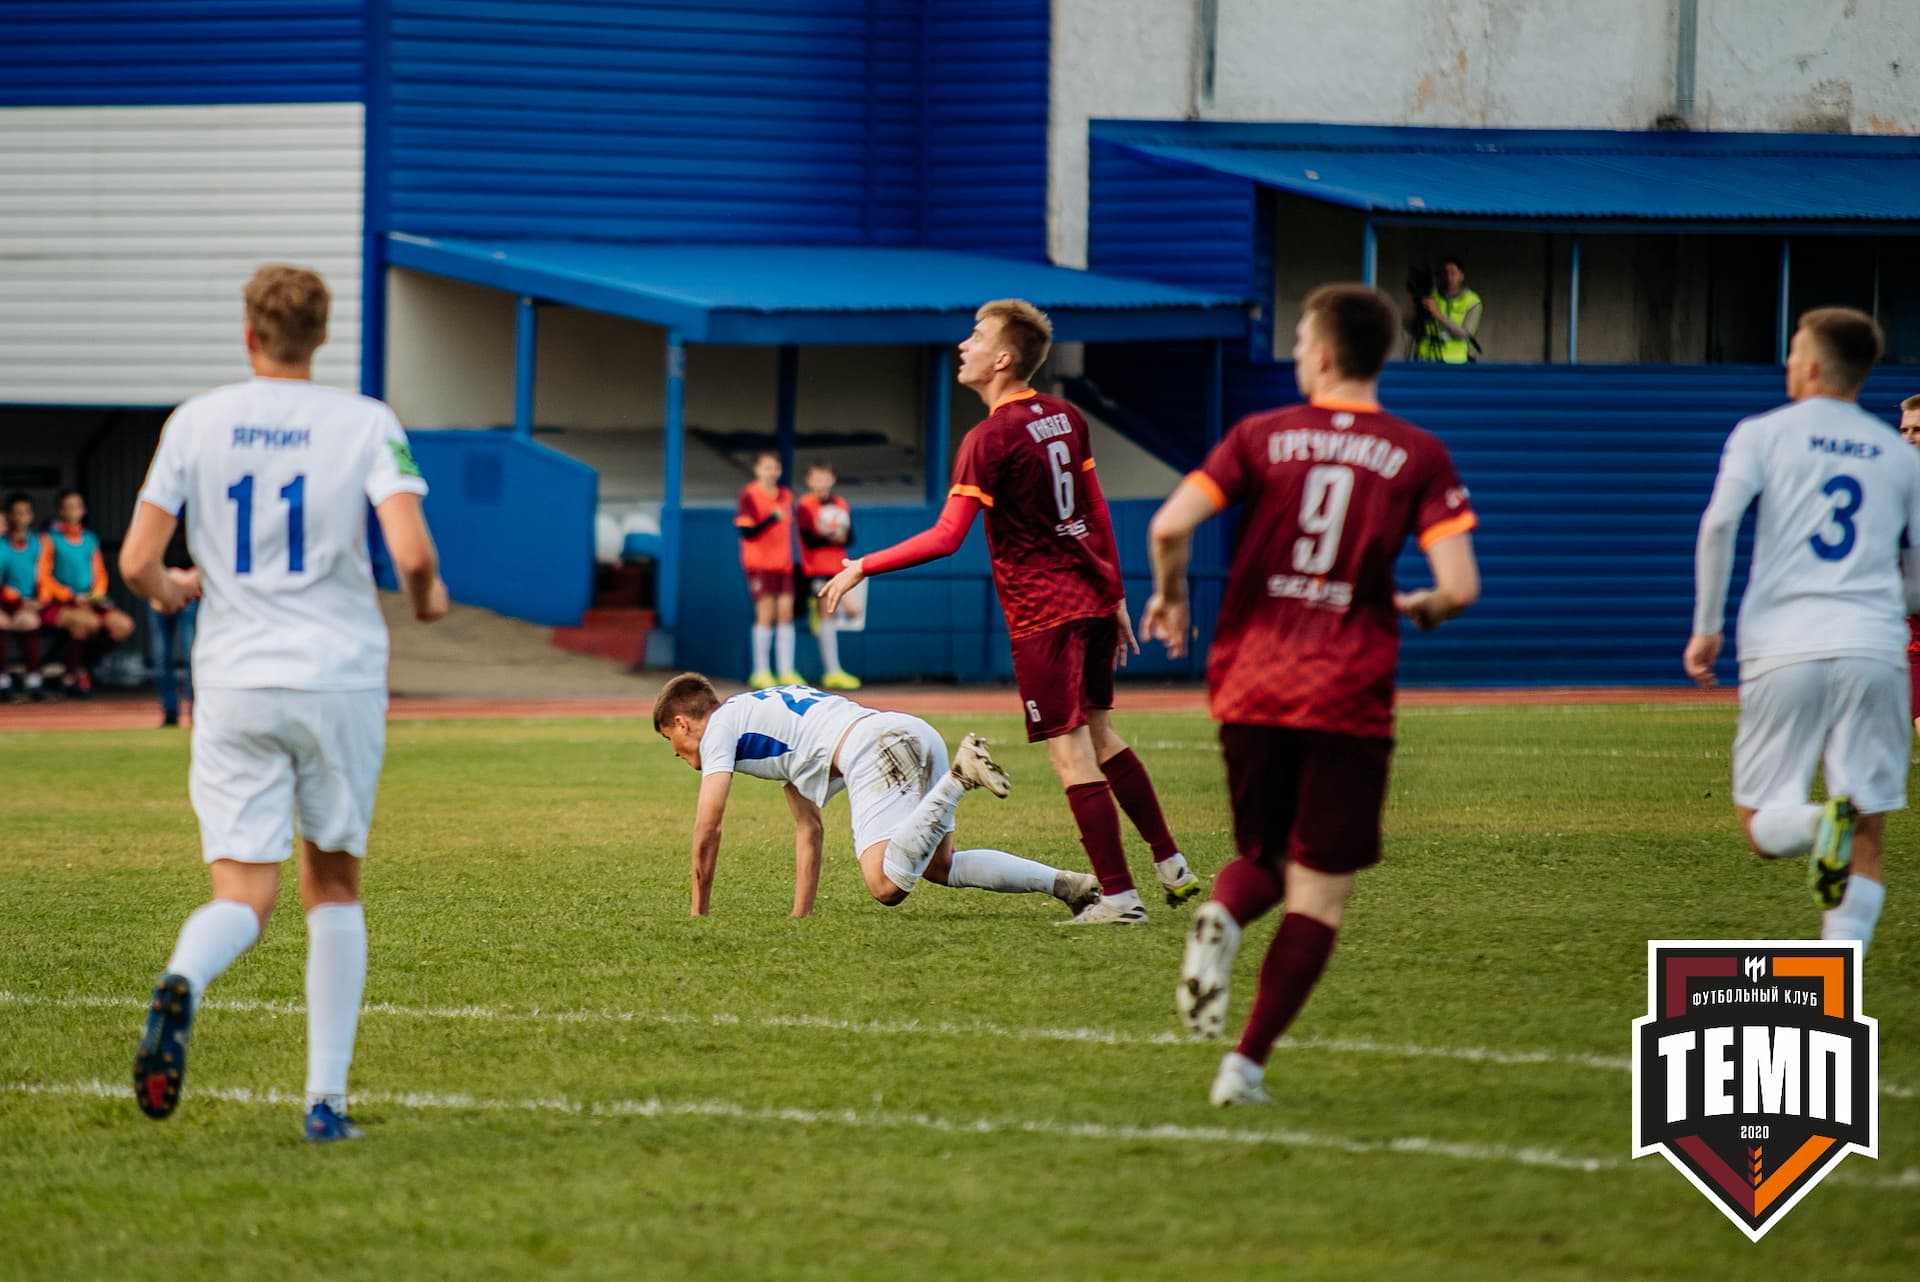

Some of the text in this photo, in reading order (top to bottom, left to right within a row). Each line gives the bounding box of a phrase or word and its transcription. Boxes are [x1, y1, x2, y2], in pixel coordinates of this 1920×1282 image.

[227, 474, 305, 574] 11
[1046, 440, 1075, 520] 6
[1292, 463, 1355, 575] 9
[1809, 474, 1864, 562] 3
[1025, 699, 1041, 723] 6
